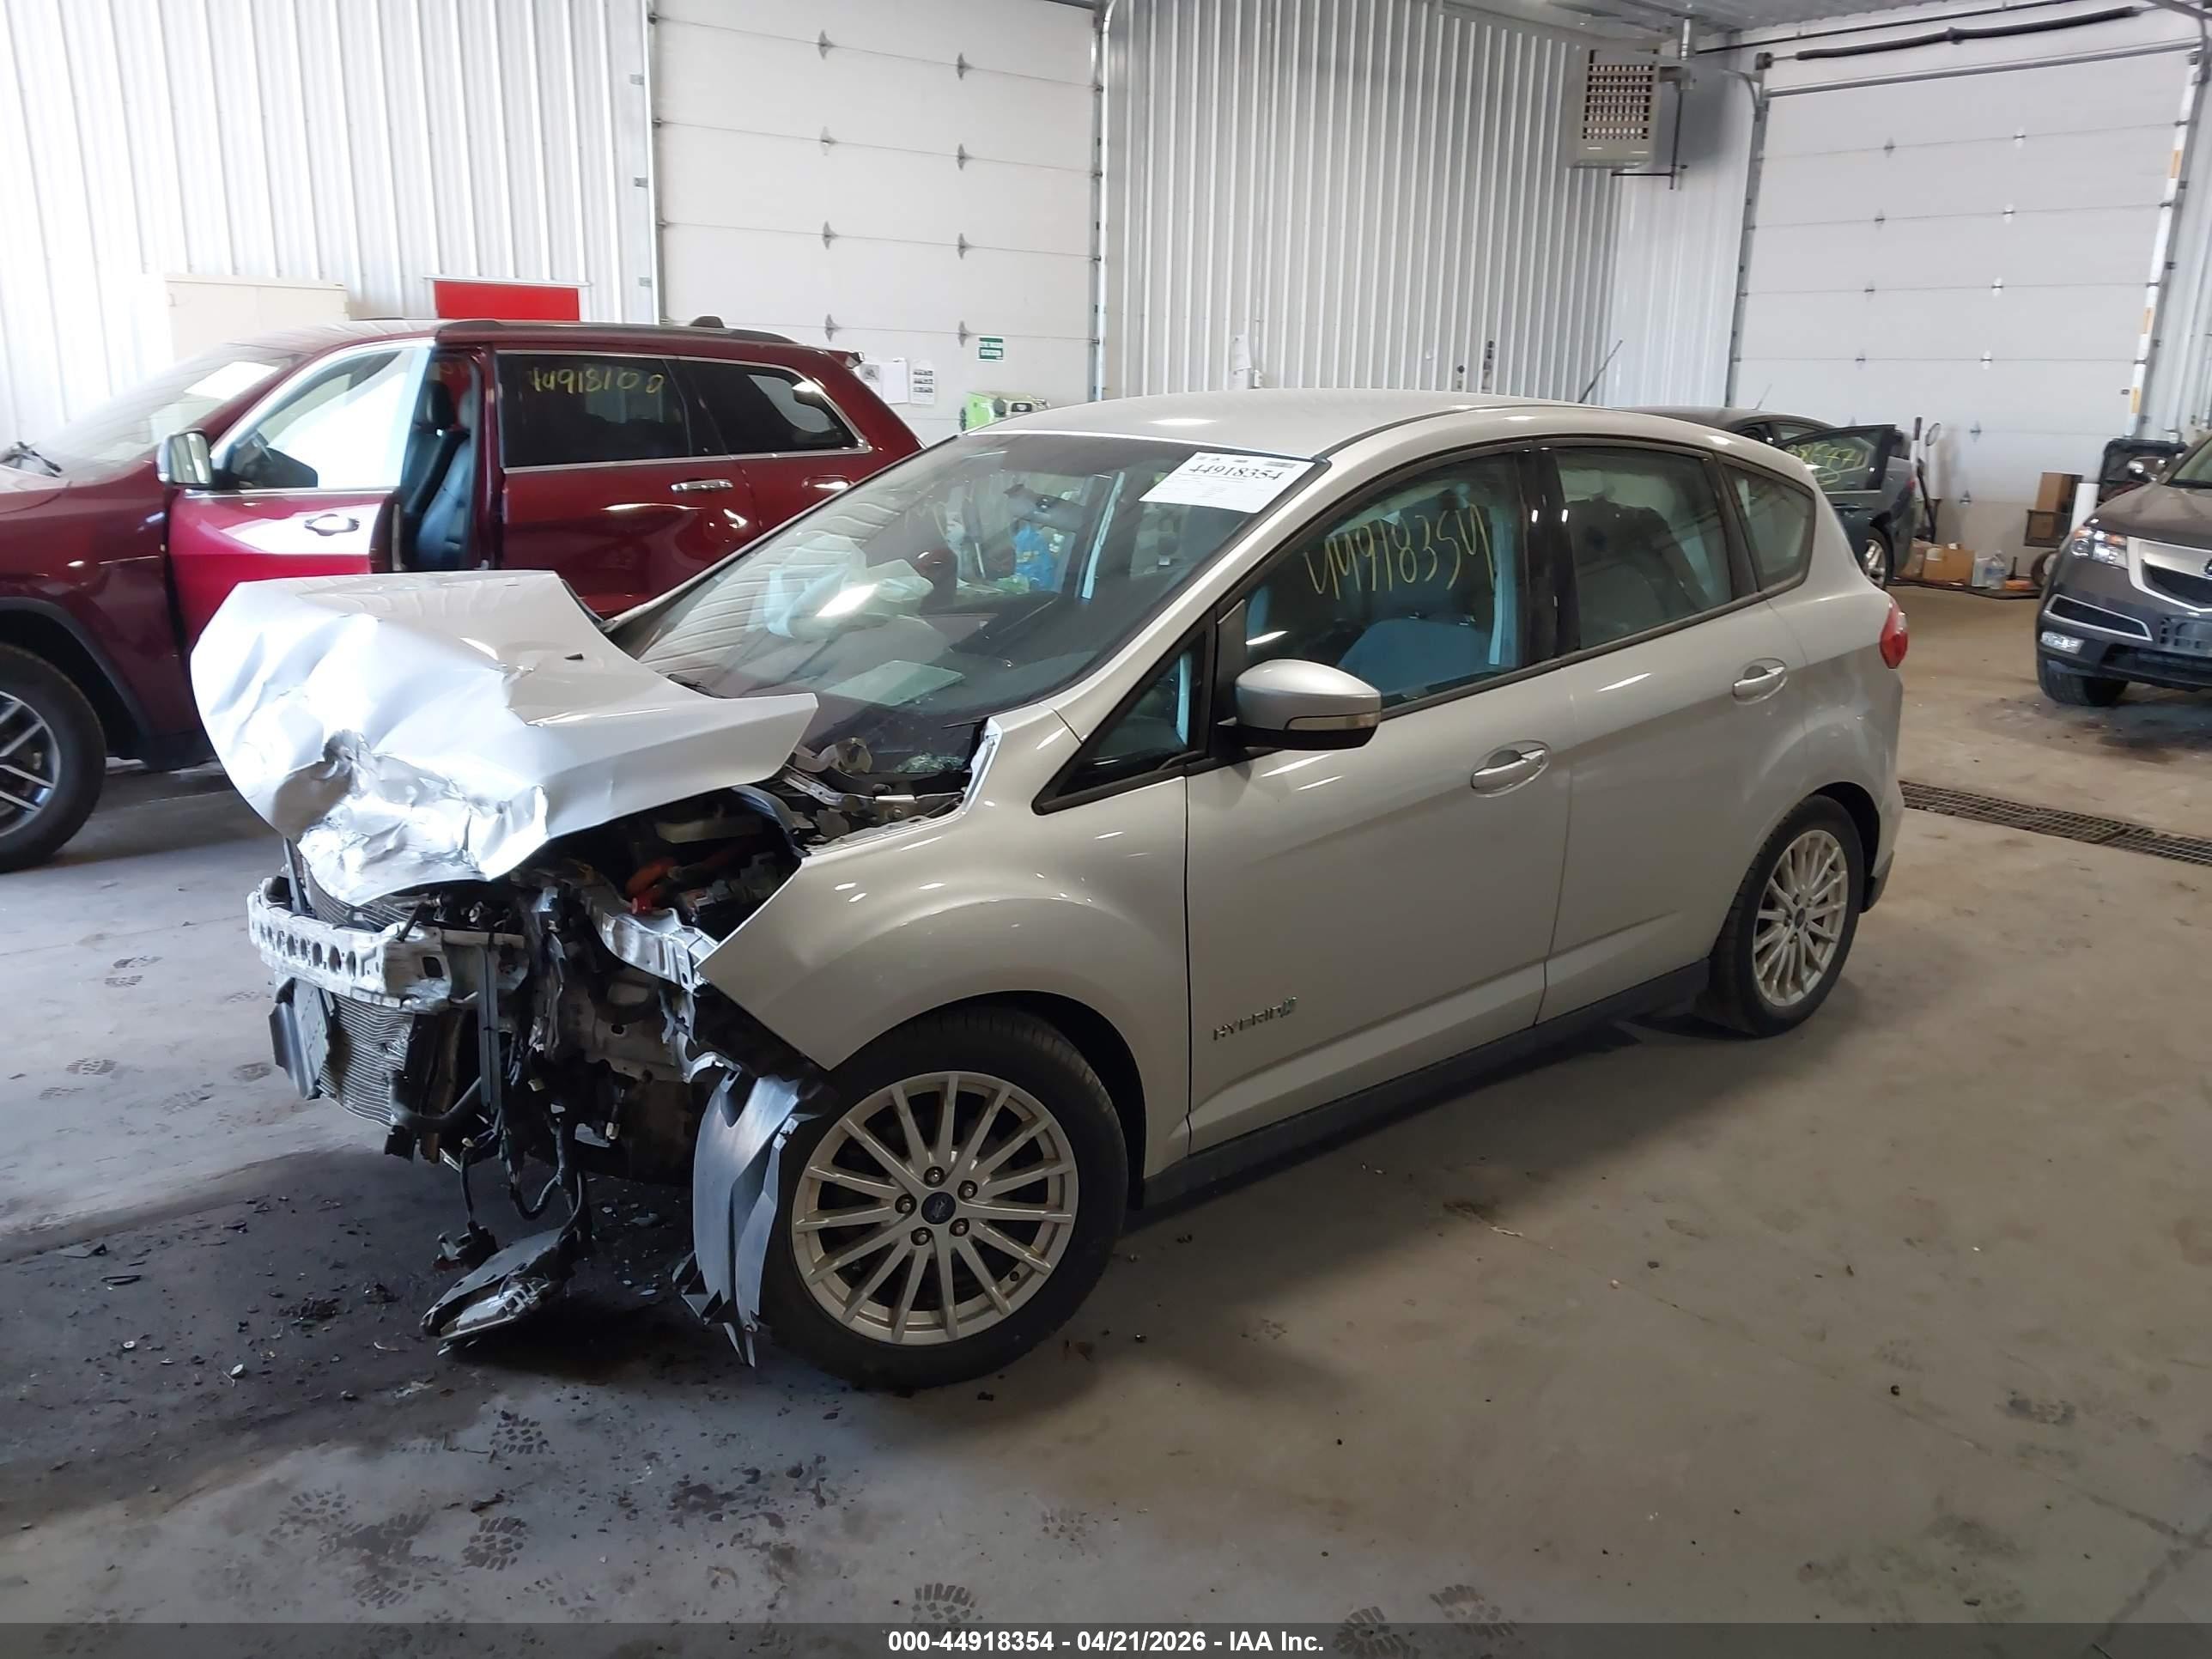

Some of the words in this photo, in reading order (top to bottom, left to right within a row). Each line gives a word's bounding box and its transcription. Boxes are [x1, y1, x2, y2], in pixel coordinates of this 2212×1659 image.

[1188, 464, 1285, 481] 44918354
[1304, 503, 1495, 600] 44918354
[1212, 1003, 1283, 1041] HYBRID
